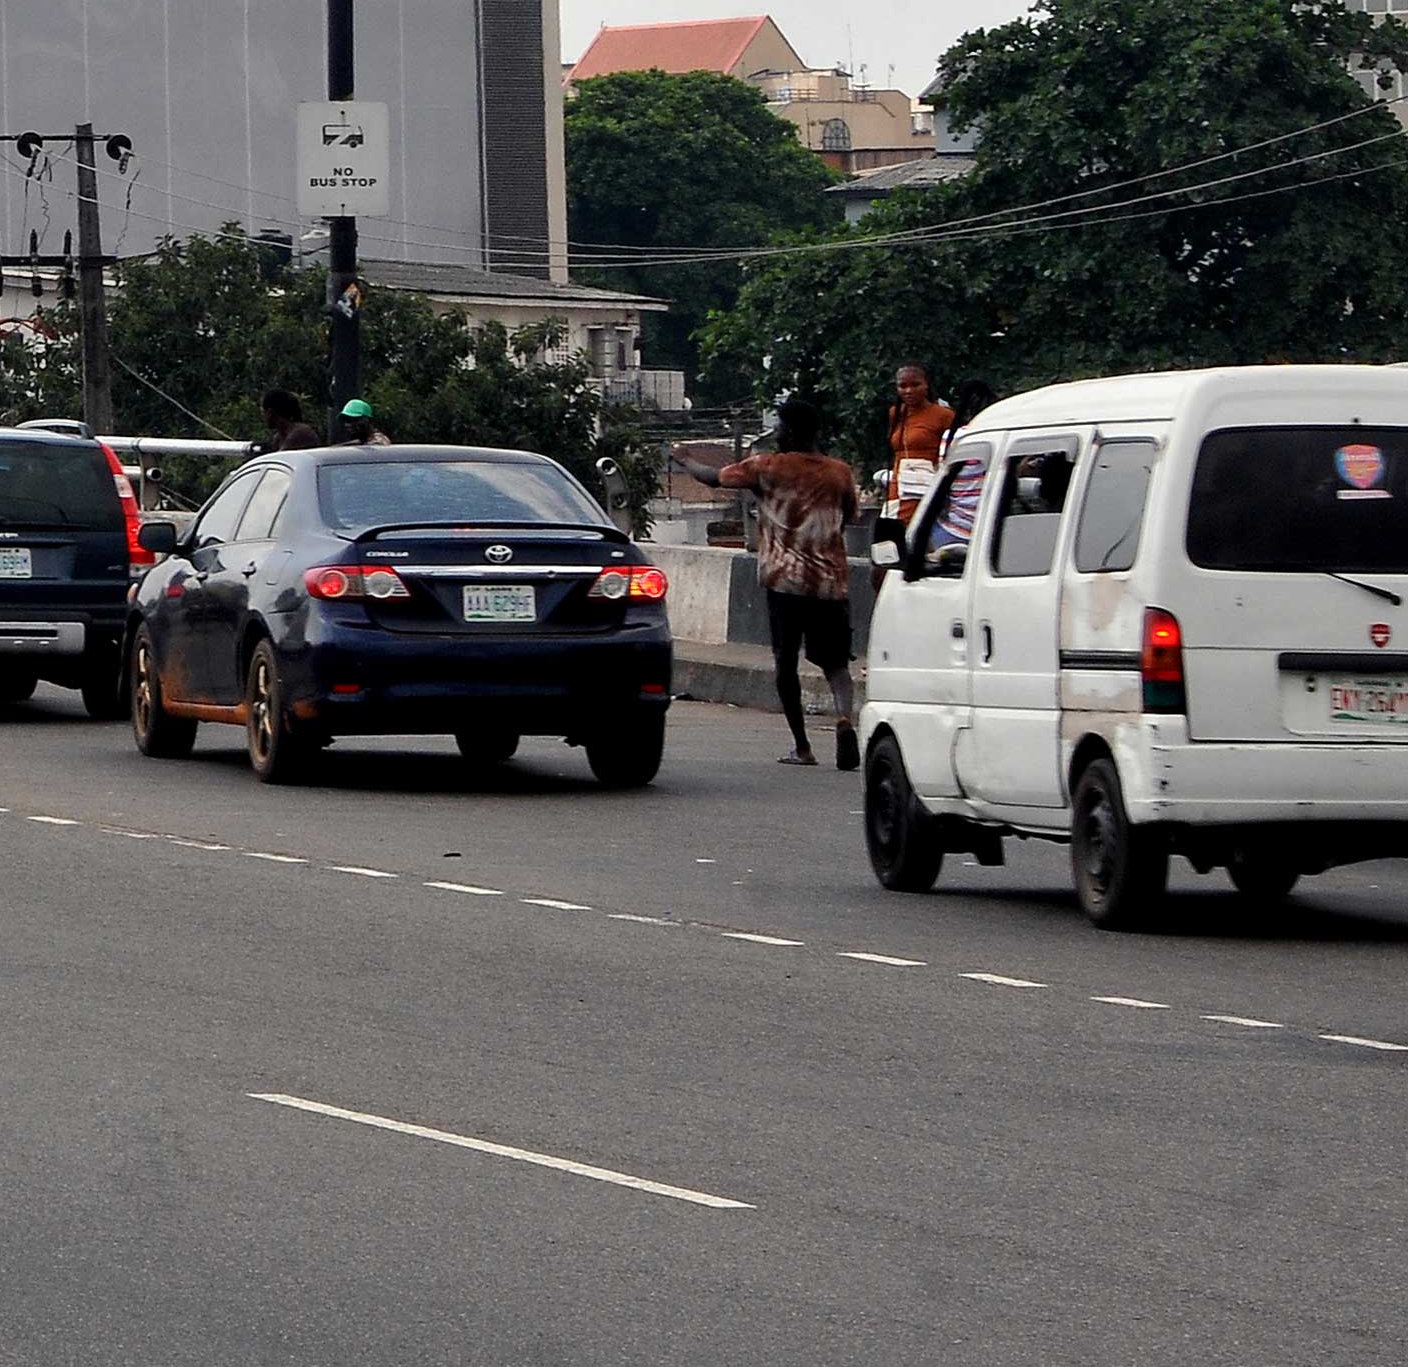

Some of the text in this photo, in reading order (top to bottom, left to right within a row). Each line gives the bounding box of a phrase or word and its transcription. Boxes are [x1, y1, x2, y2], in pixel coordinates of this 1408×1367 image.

[333, 167, 354, 177] NO
[310, 178, 377, 187] BUS STOP
